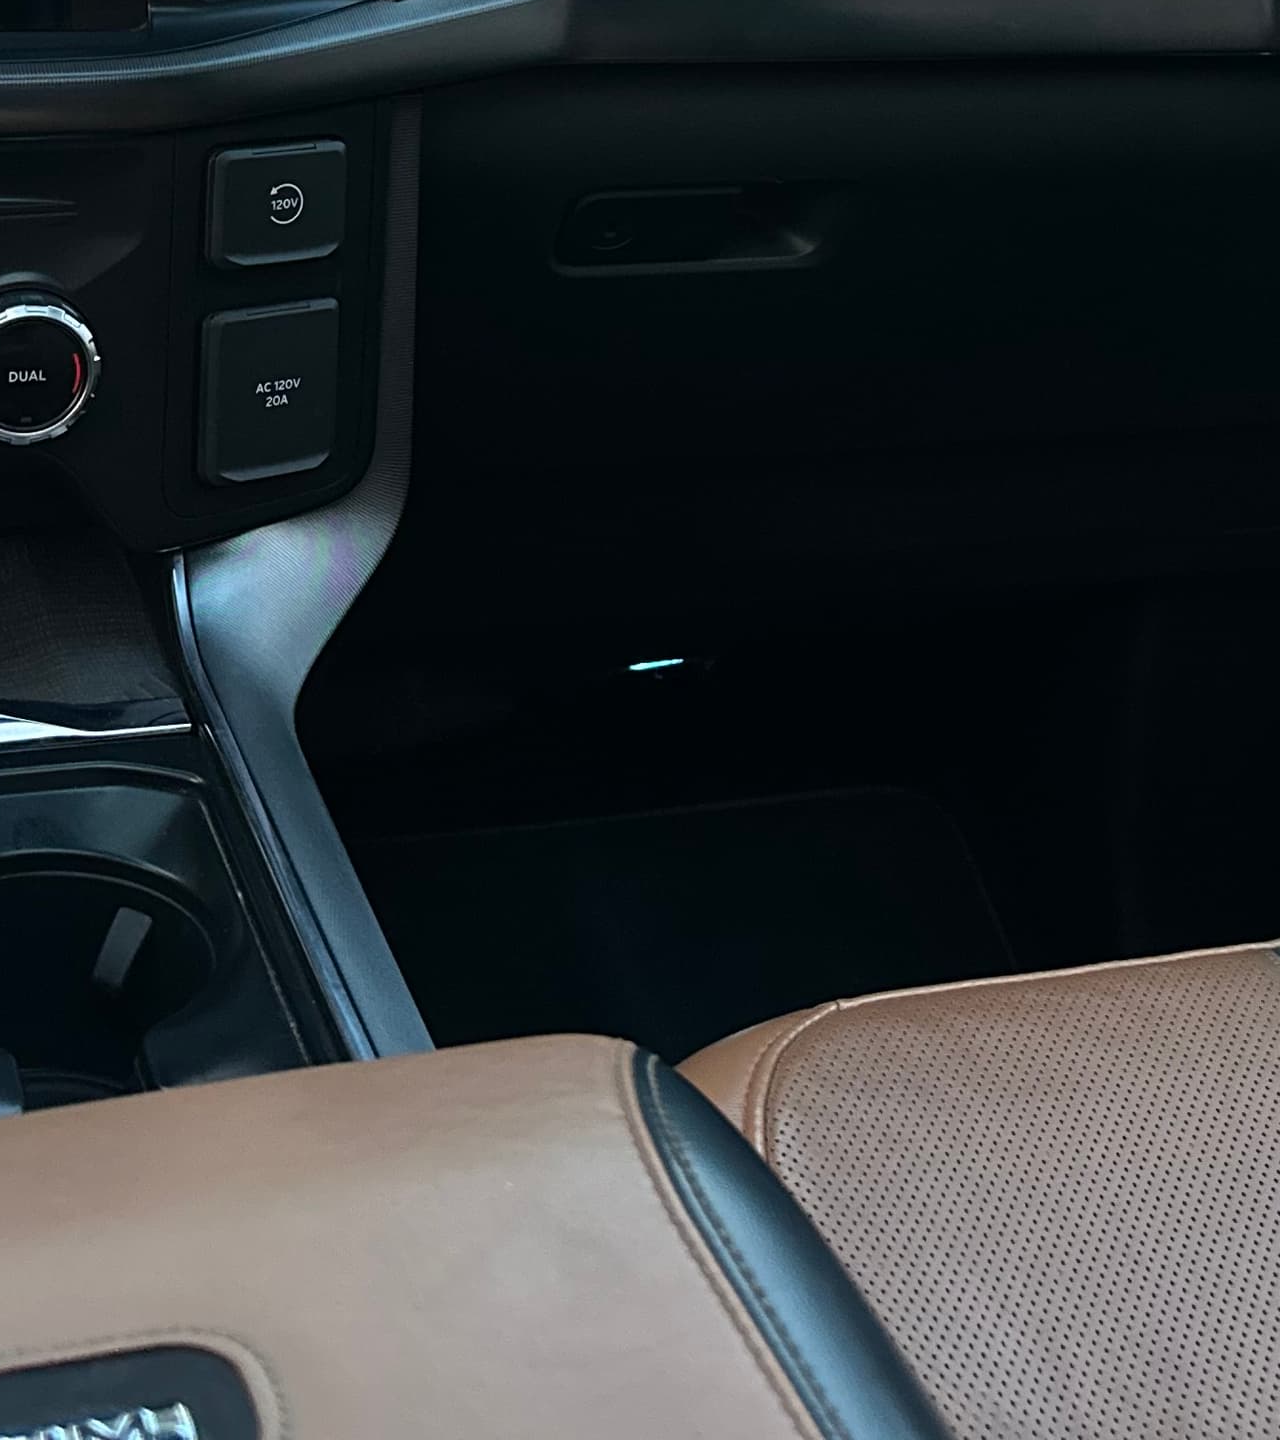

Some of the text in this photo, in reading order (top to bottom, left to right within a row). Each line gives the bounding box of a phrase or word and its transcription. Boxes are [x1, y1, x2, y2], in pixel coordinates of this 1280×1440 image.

[271, 197, 299, 211] 120V
[8, 369, 47, 383] DUAL
[255, 376, 302, 394] AC 120V
[265, 394, 289, 408] 20A
